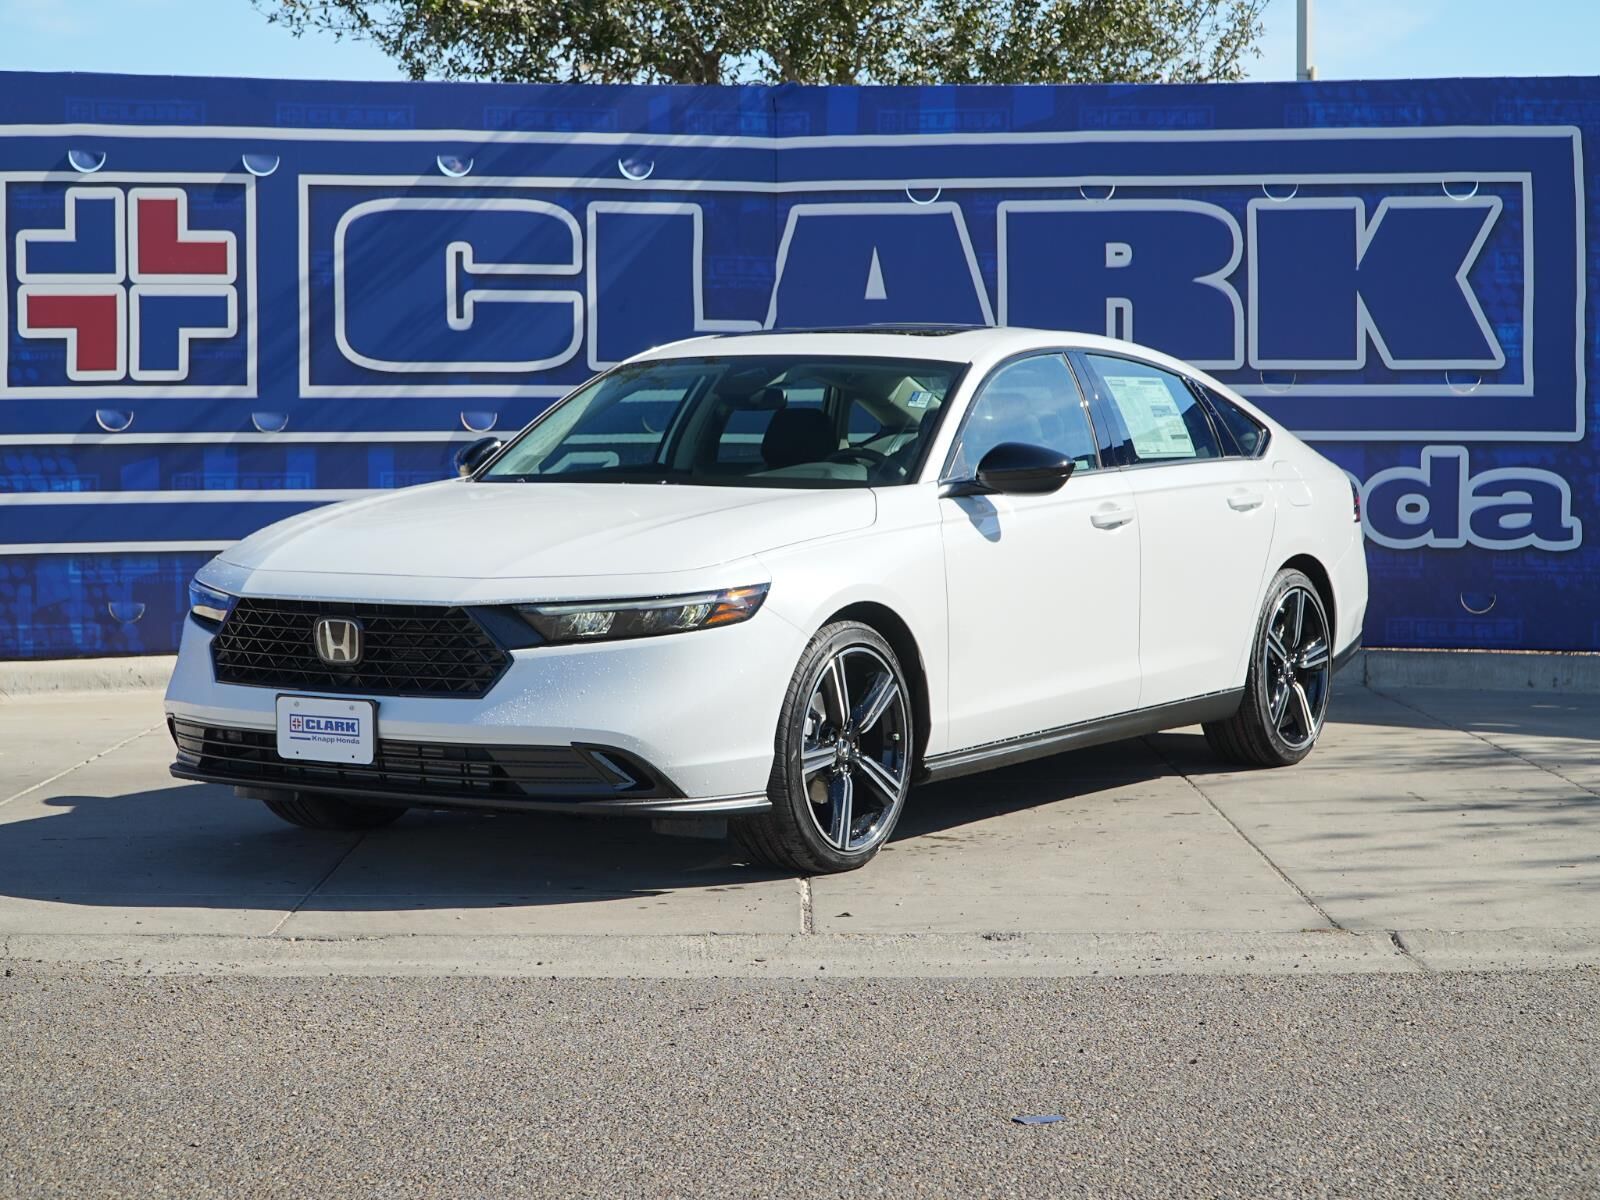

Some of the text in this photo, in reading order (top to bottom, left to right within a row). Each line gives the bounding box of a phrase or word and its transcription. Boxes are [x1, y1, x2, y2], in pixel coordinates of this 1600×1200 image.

[334, 196, 1506, 373] CLARK
[1342, 445, 1583, 551] da
[305, 719, 356, 733] CLARK
[311, 735, 360, 745] Knapp Honda
